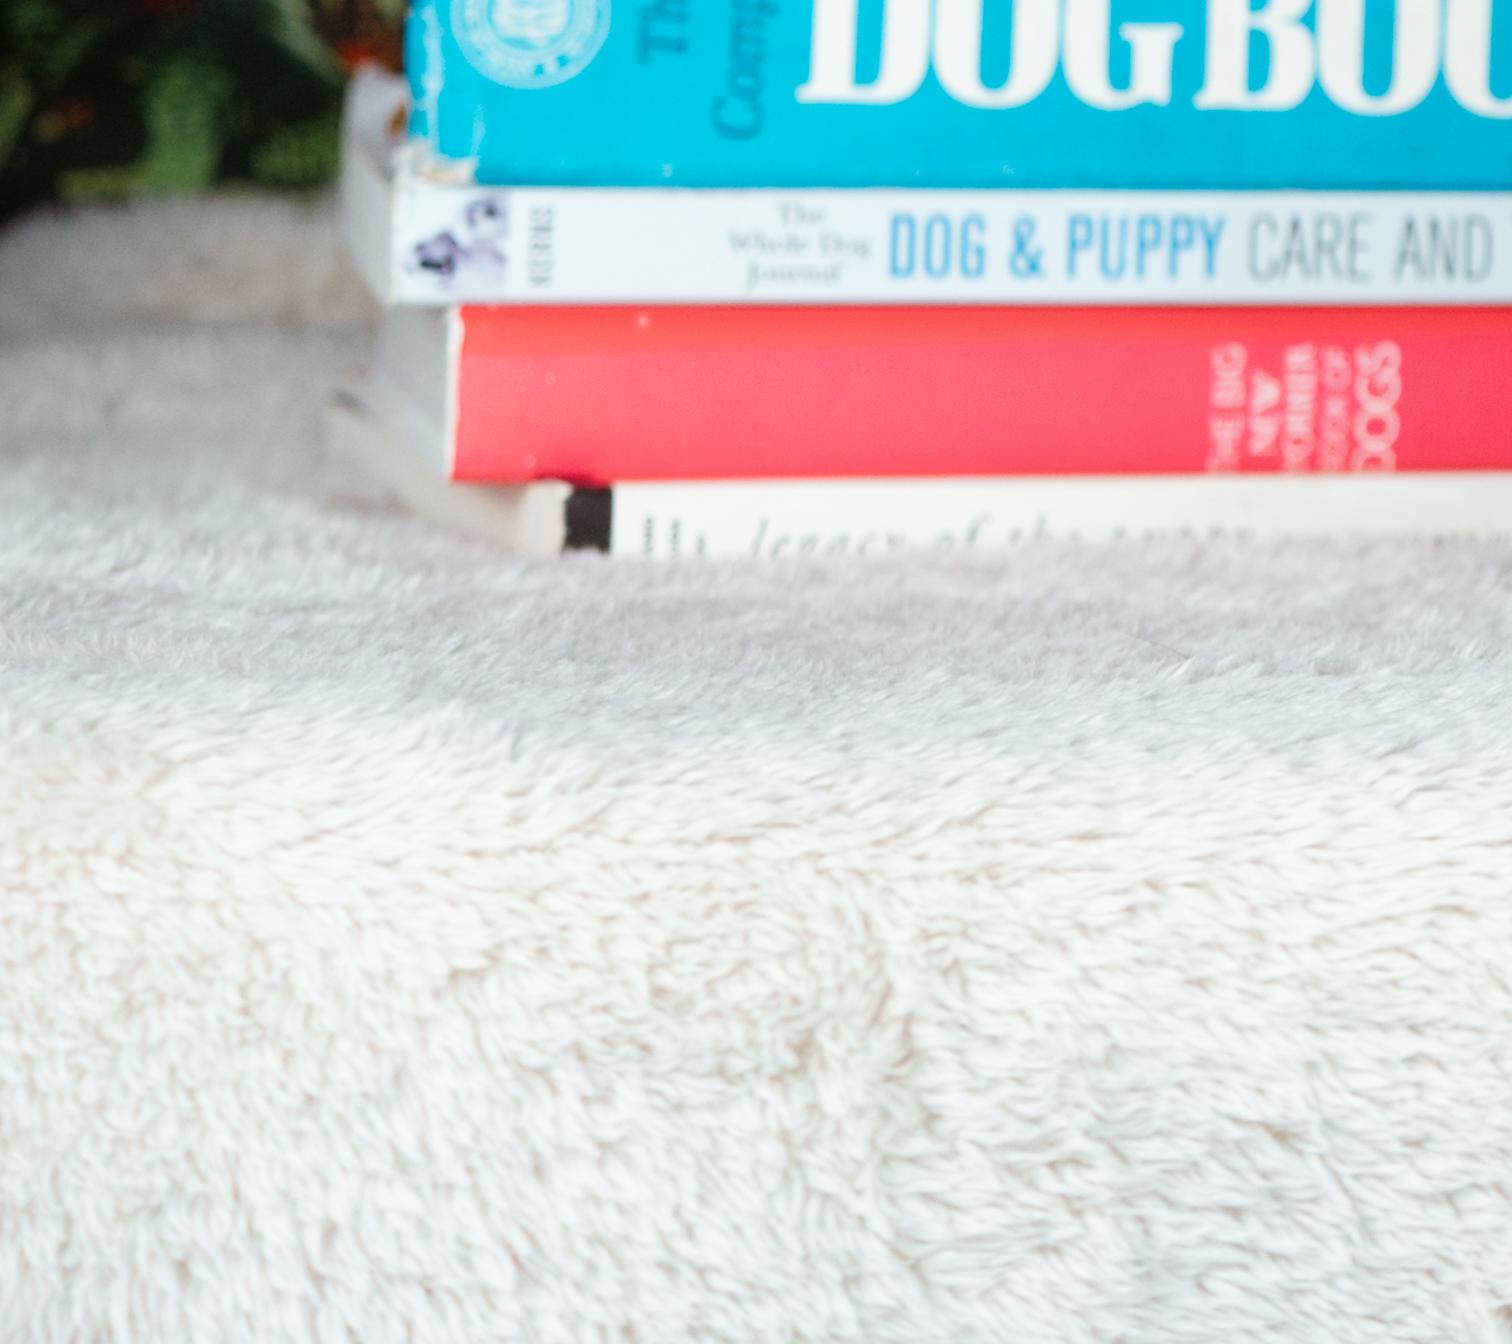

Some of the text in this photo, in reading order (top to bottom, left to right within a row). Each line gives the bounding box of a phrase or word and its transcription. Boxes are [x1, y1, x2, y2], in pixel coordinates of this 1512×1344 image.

[778, 201, 827, 226] The
[888, 213, 987, 279] DOG
[1008, 214, 1045, 279] &
[1065, 213, 1226, 279] PUPPY
[1248, 214, 1373, 281] CARE
[1394, 215, 1493, 281] AND
